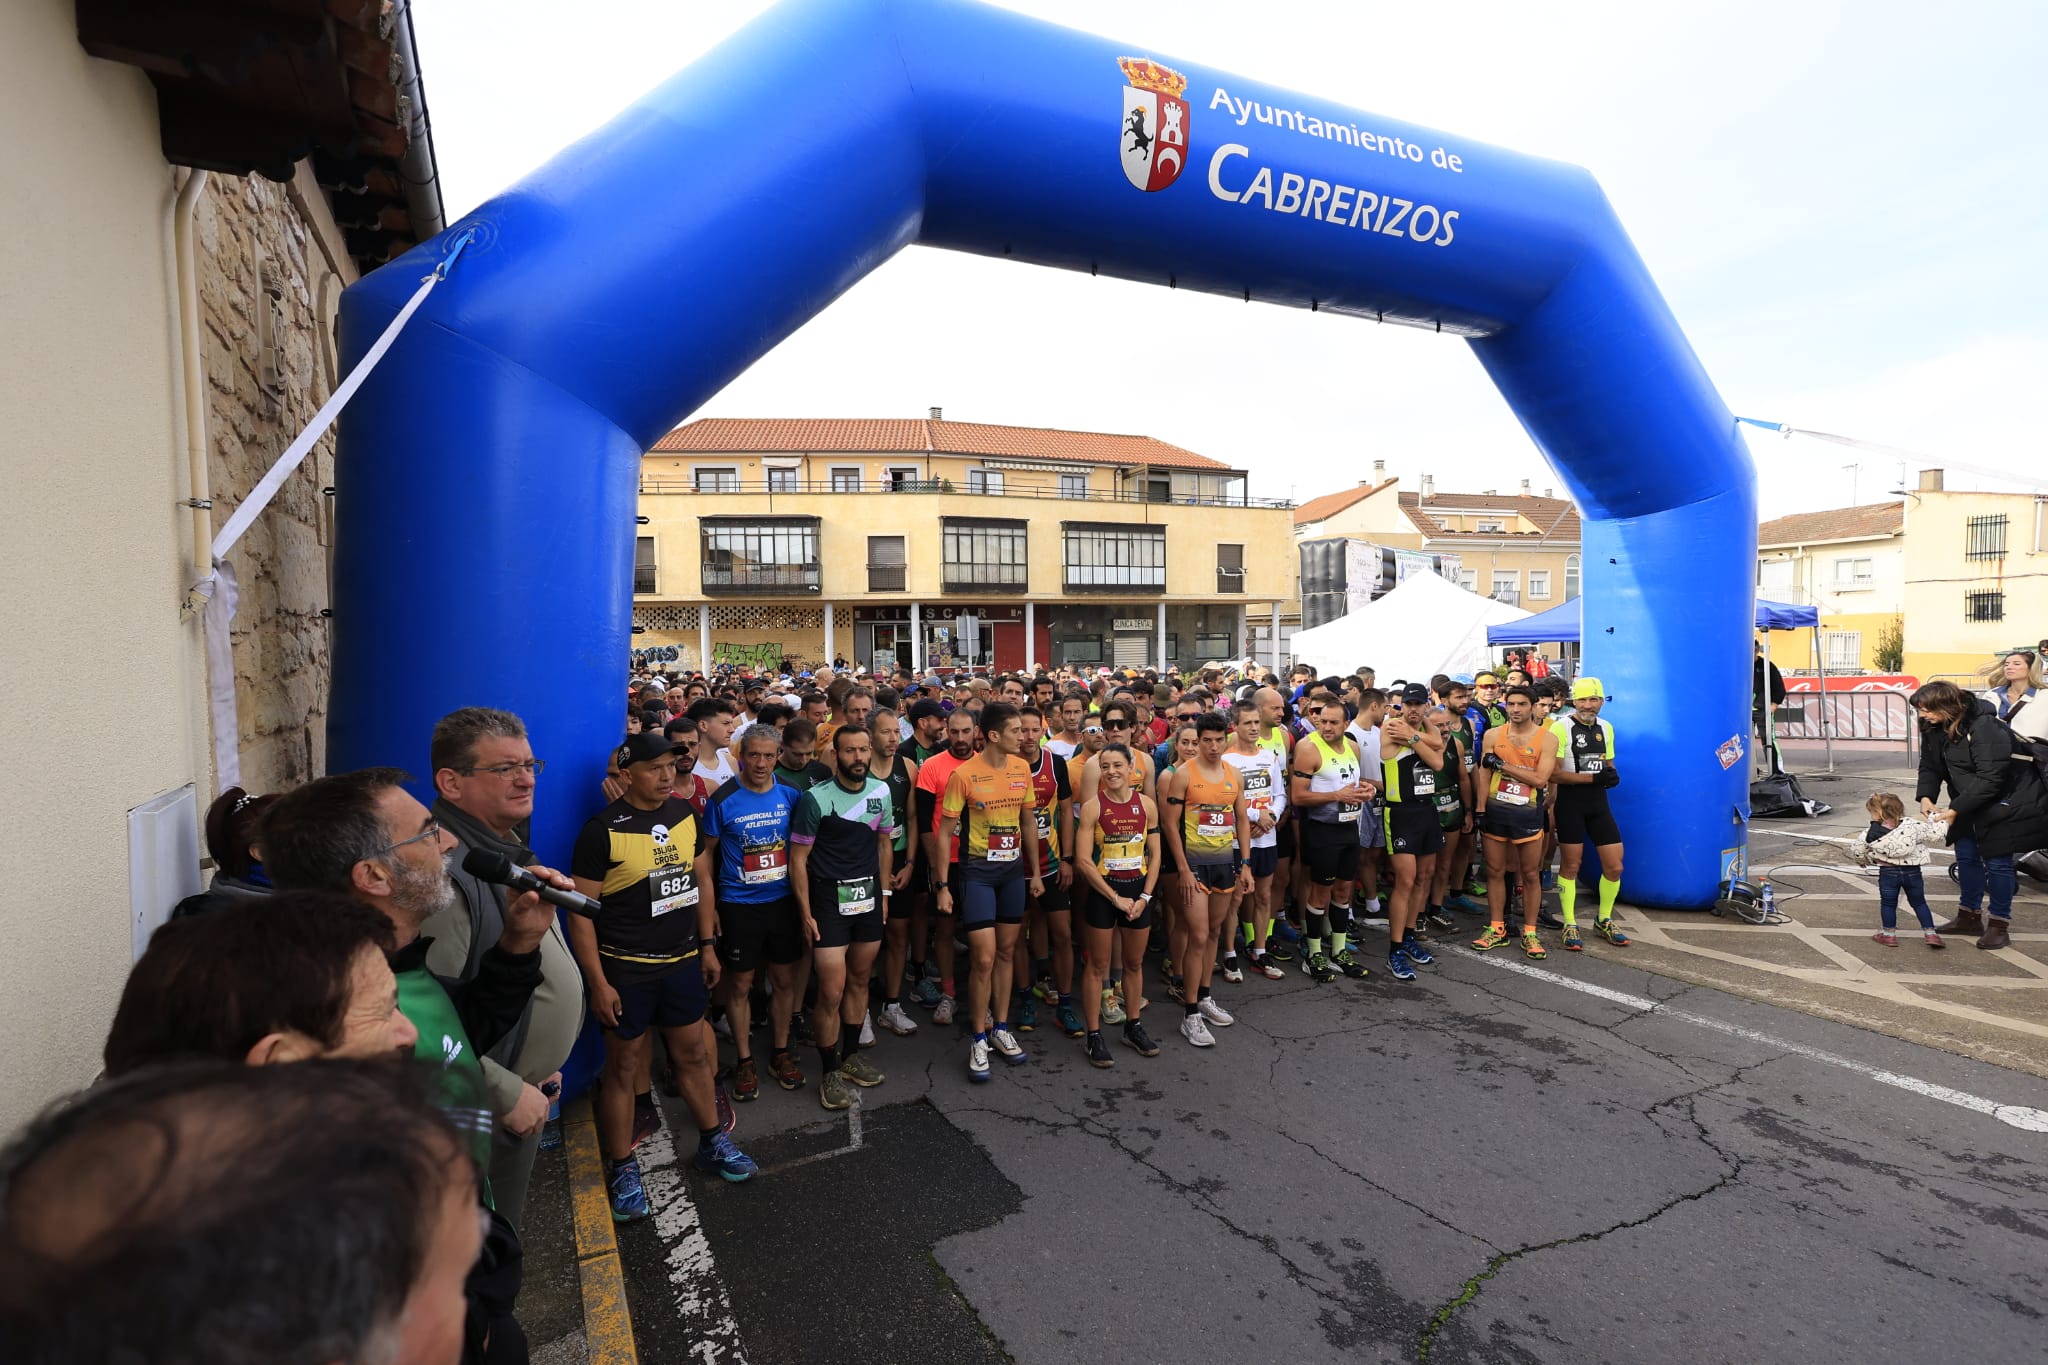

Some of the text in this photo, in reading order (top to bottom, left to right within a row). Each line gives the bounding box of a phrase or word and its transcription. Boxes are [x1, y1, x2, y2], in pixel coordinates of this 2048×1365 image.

[1209, 87, 1463, 173] Ayuntamiento de
[1208, 143, 1459, 247] CABRERIZOS
[1587, 760, 1603, 771] 471
[1247, 777, 1266, 789] 250
[1506, 783, 1521, 795] 26
[1440, 795, 1452, 805] 99
[734, 811, 773, 823] COMERCIAL
[1209, 813, 1224, 825] 38
[744, 818, 781, 829] ATLETISMO
[1000, 836, 1014, 849] 33
[1121, 845, 1127, 856] 1
[654, 853, 679, 865] CROSS
[759, 853, 775, 868] 51
[660, 874, 691, 896] 682
[851, 886, 866, 901] 79
